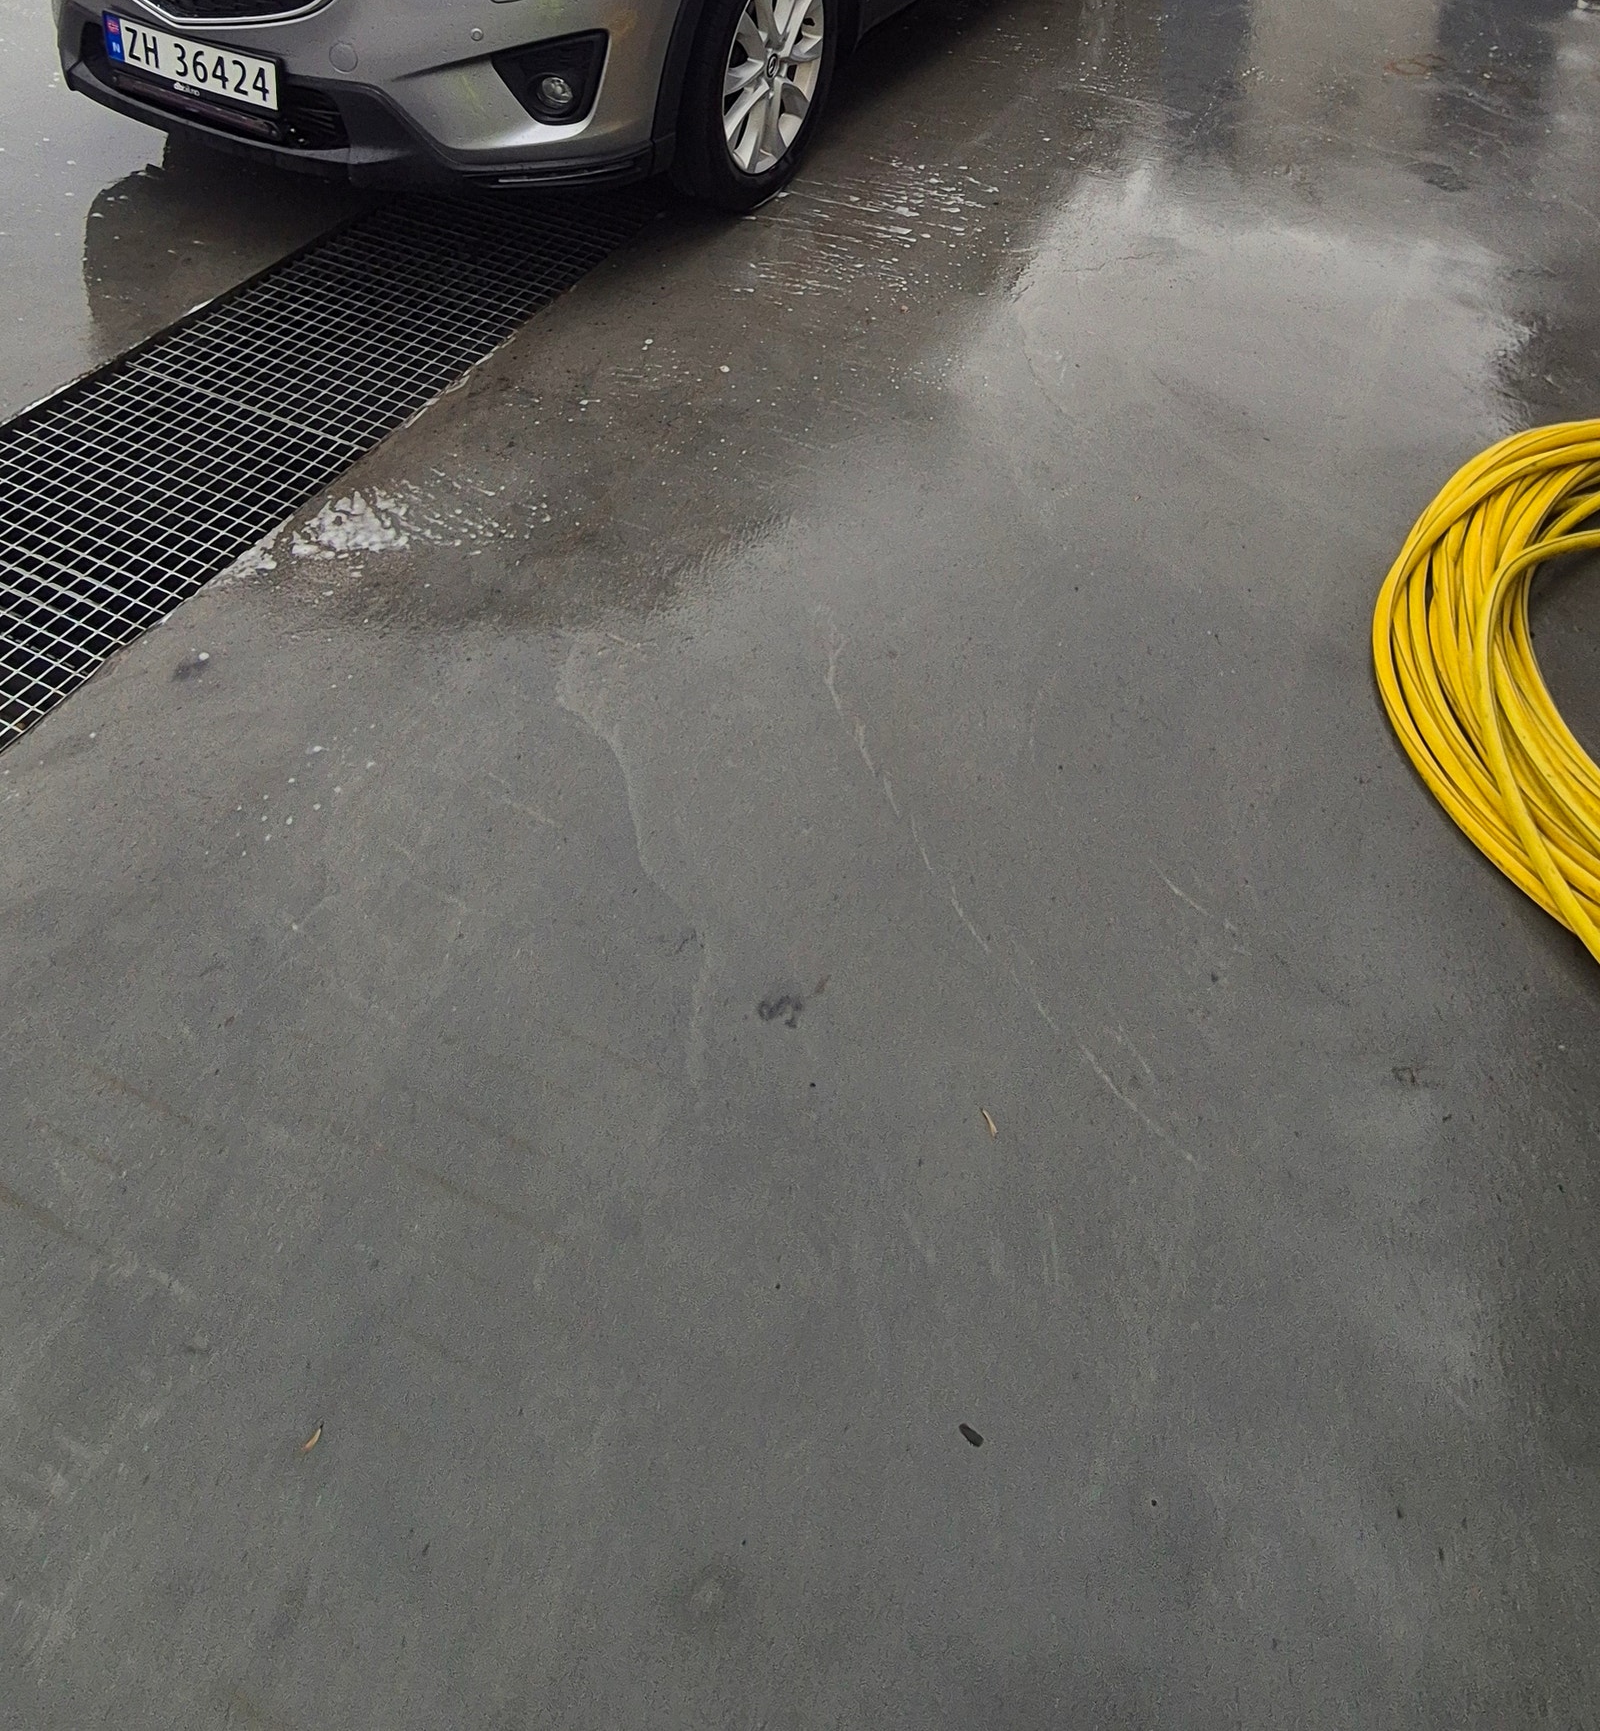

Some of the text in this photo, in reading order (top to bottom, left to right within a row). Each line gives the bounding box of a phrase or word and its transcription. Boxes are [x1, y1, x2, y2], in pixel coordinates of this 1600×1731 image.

[112, 41, 121, 54] N
[124, 26, 270, 102] ZH 36424
